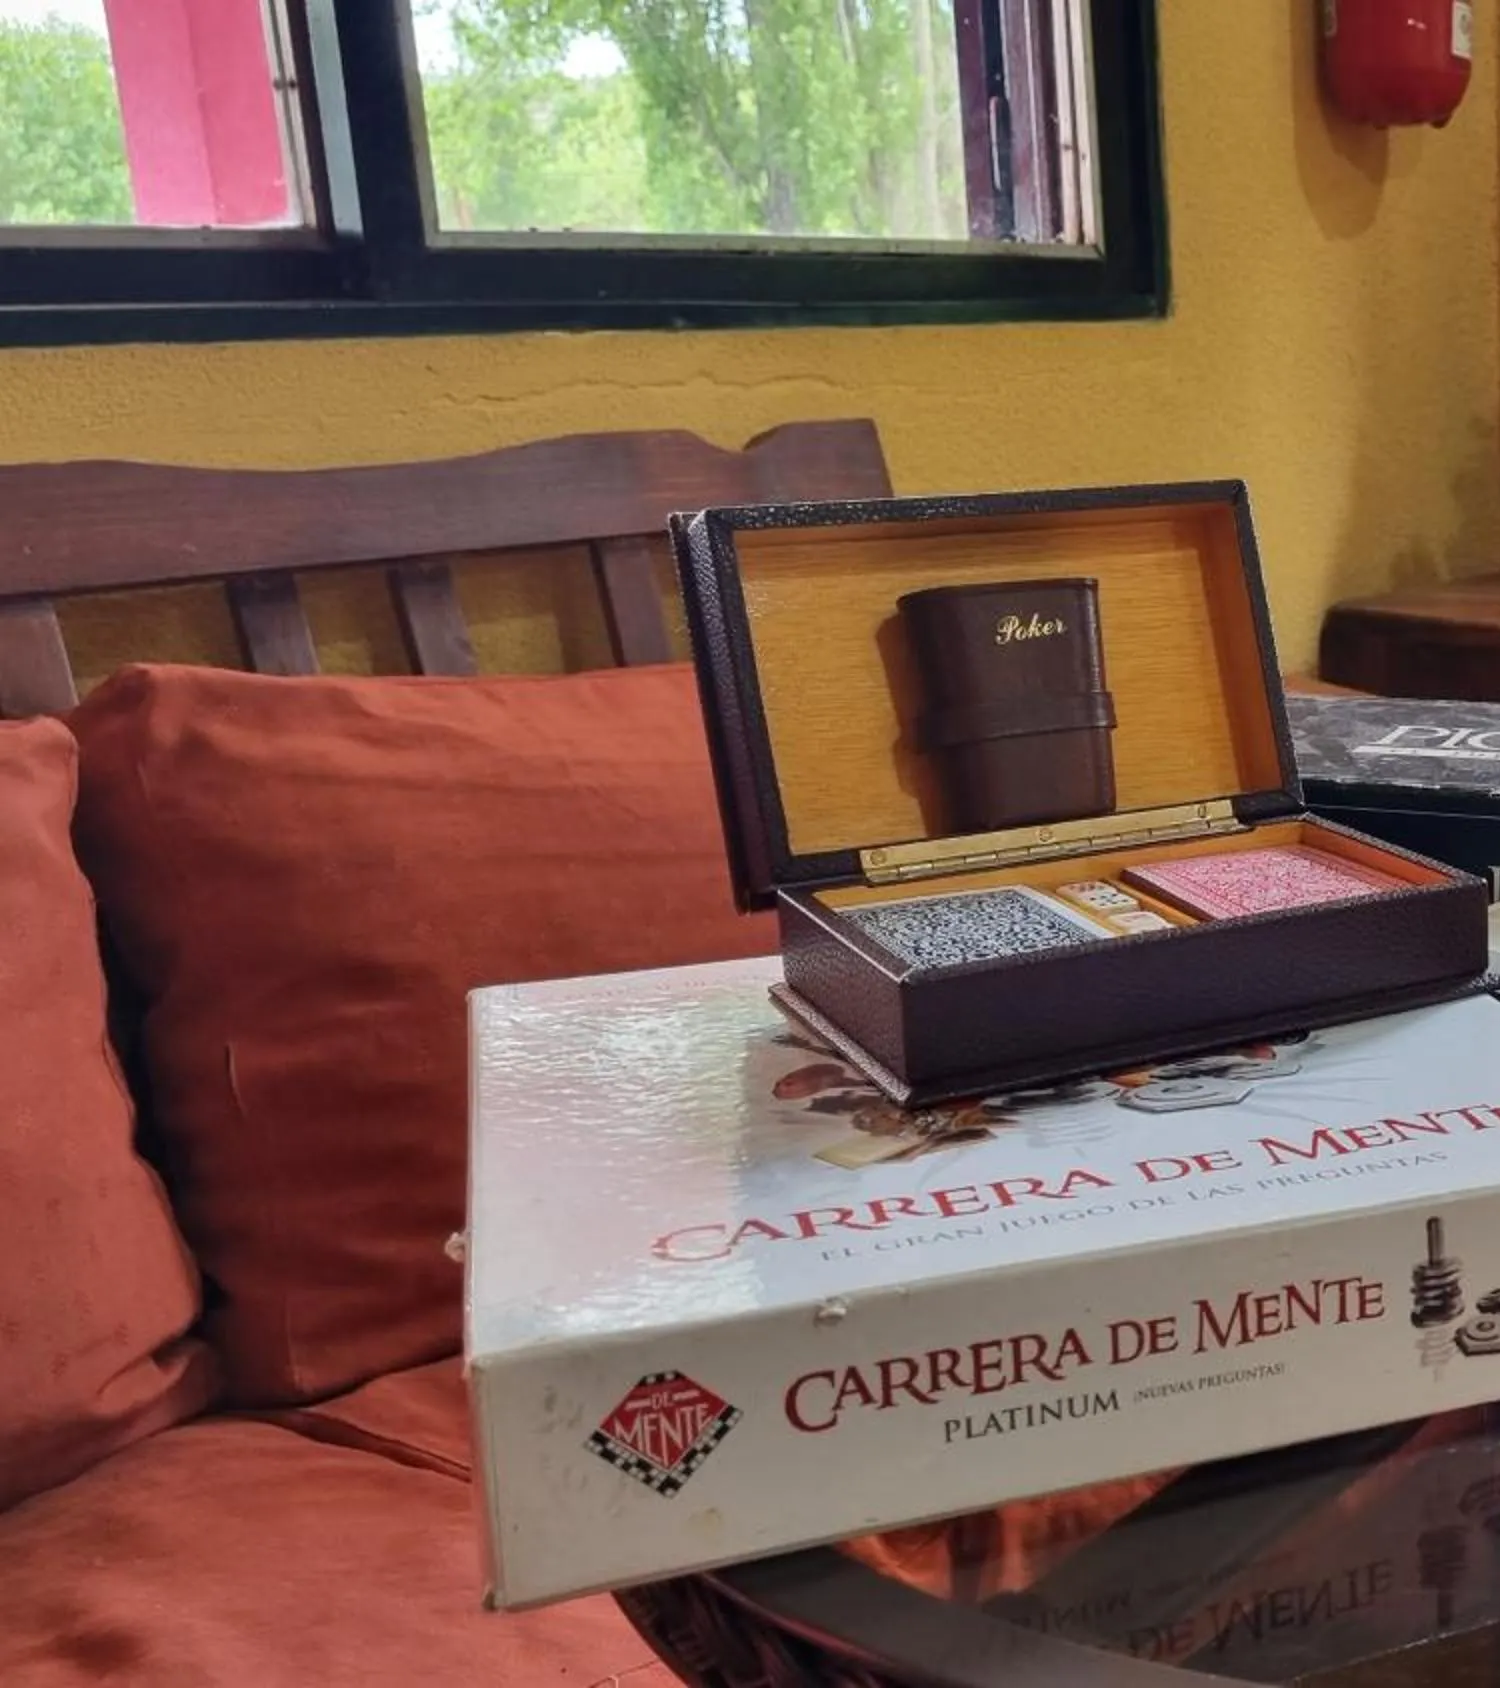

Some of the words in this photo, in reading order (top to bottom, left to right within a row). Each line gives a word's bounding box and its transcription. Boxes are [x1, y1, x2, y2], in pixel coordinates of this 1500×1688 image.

[995, 613, 1068, 645] Poker
[650, 1168, 1115, 1263] CARRERA
[1135, 1149, 1243, 1183] DE
[820, 1246, 858, 1262] EL
[874, 1225, 984, 1253] GRAN
[999, 1203, 1117, 1234] JUEGO
[1130, 1194, 1177, 1211] DE
[1186, 1183, 1245, 1201] LAS
[1256, 1150, 1450, 1191] PREGUNTAS
[783, 1328, 1093, 1433] CARRERA
[1108, 1315, 1179, 1366] DE
[1193, 1276, 1386, 1355] MENTE
[612, 1402, 715, 1468] MENTE
[943, 1388, 1121, 1443] PLATINUM
